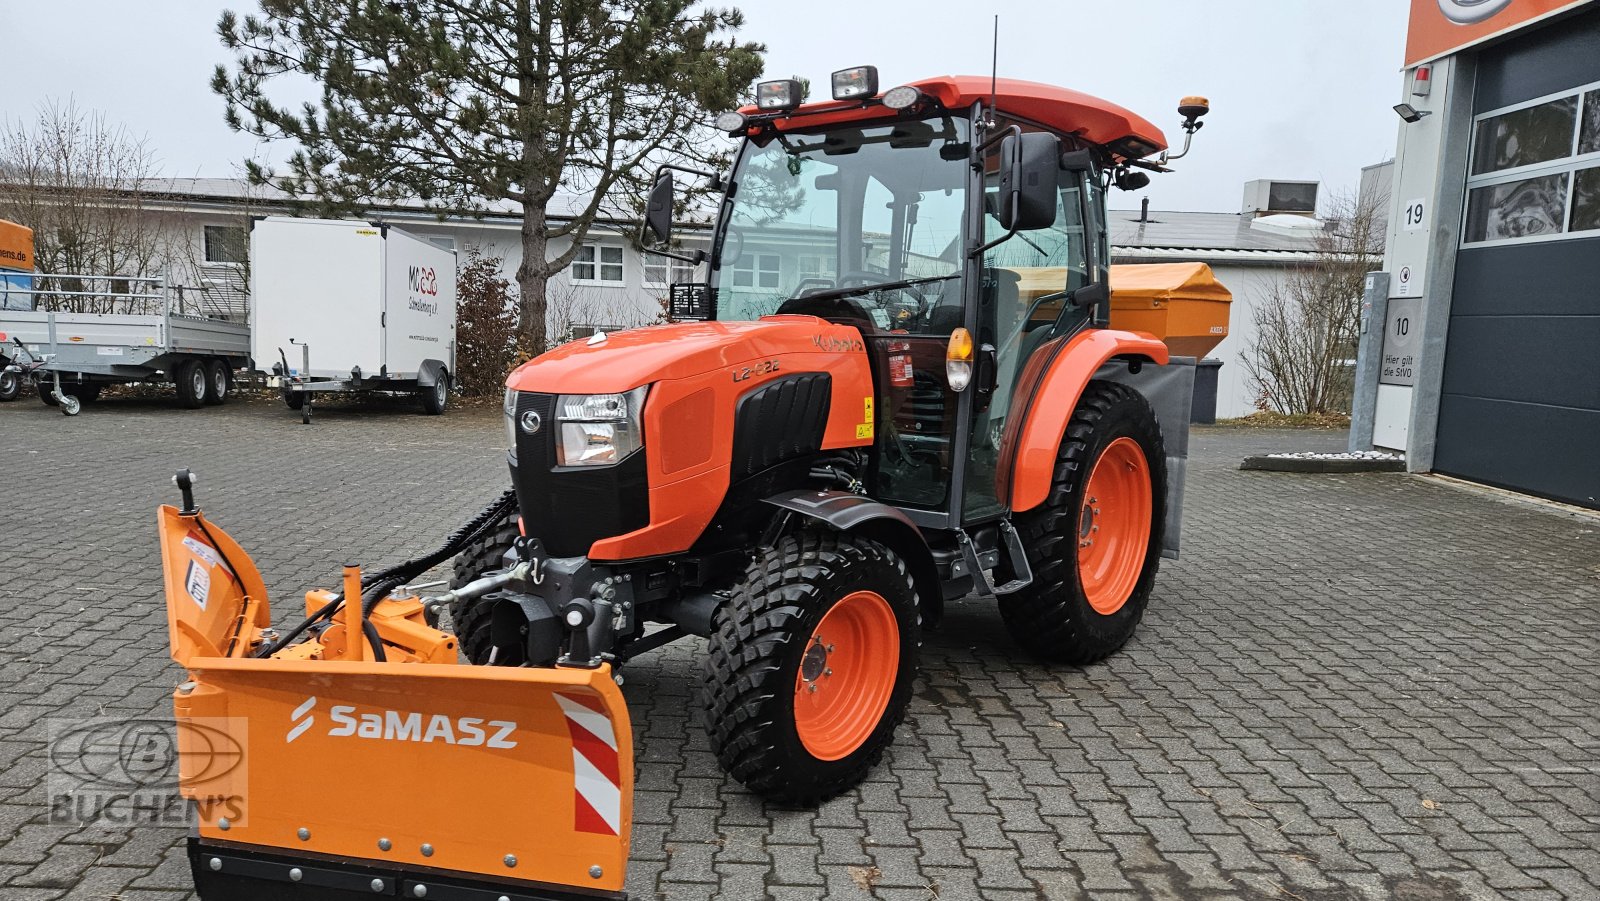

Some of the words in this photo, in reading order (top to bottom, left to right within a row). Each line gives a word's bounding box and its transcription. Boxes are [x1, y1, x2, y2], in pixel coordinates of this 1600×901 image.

[1406, 204, 1423, 225] 19
[1397, 317, 1409, 335] 10
[812, 335, 863, 351] Kubota
[1385, 354, 1399, 365] Hier
[1402, 355, 1413, 367] gilt
[1384, 367, 1394, 377] die
[1396, 367, 1412, 378] StVO
[327, 705, 518, 749] SaMASZ
